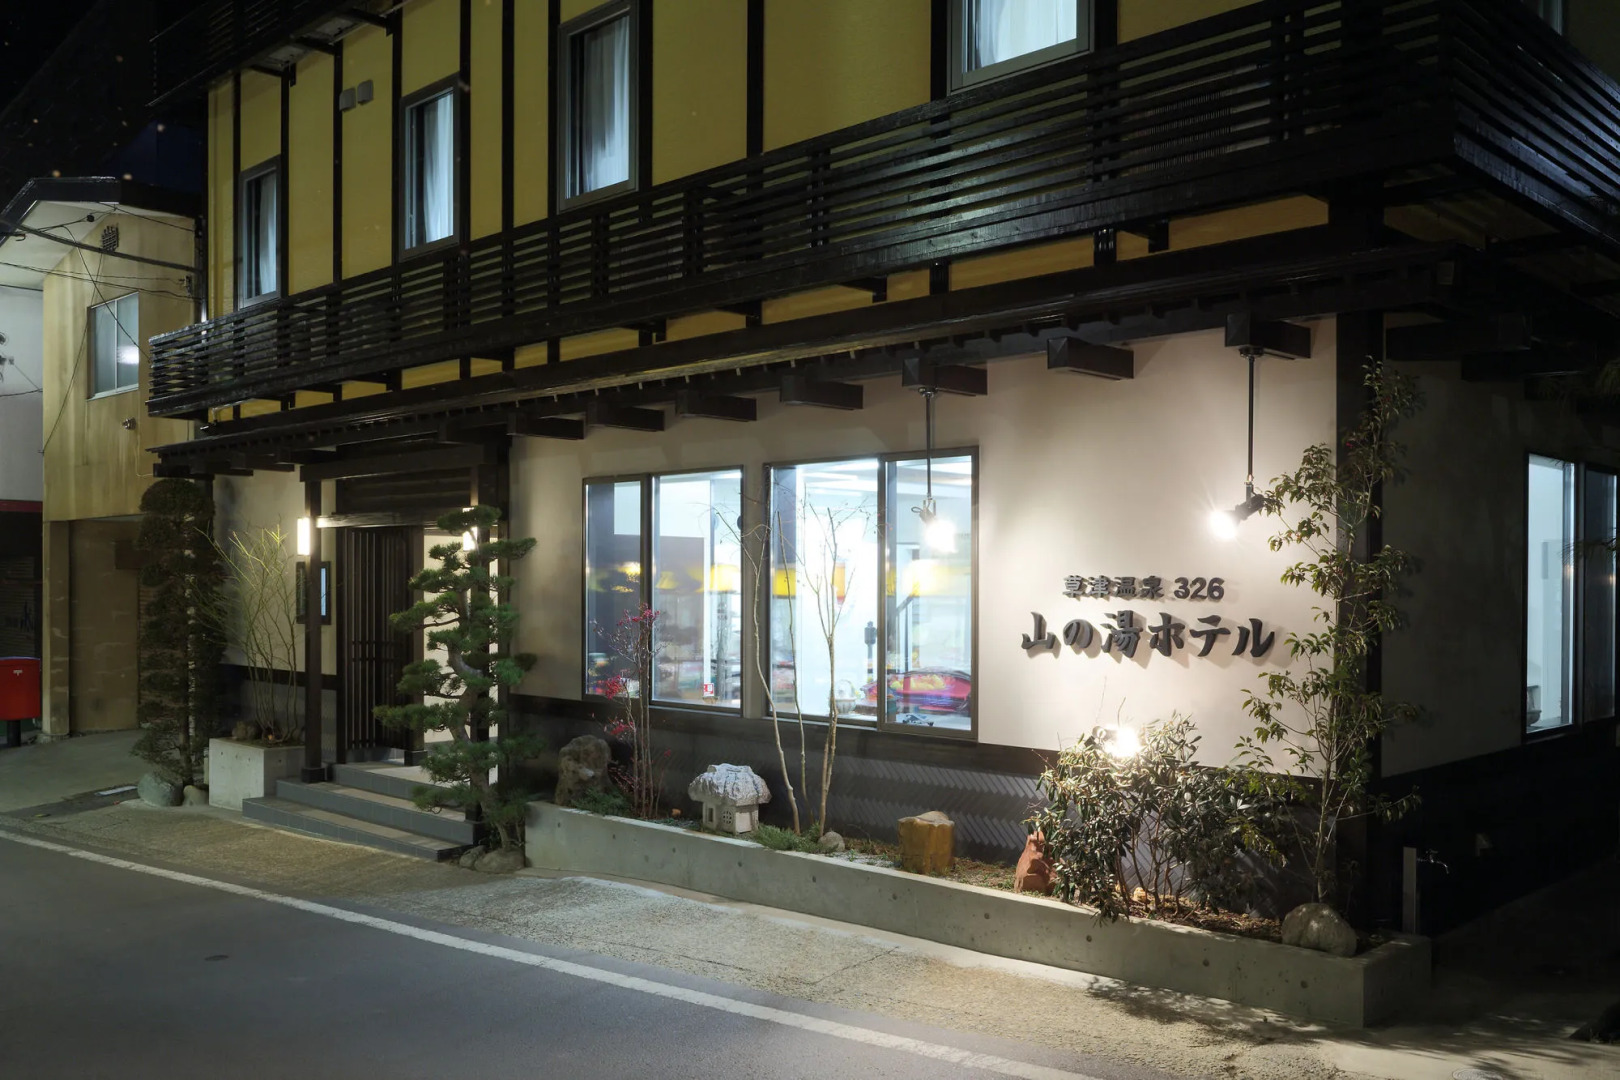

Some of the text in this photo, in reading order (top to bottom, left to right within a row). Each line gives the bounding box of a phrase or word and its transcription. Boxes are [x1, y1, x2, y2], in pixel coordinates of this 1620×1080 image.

[1063, 575, 1225, 600] 草津温泉 326
[1021, 610, 1275, 659] 山の湯ホテル
